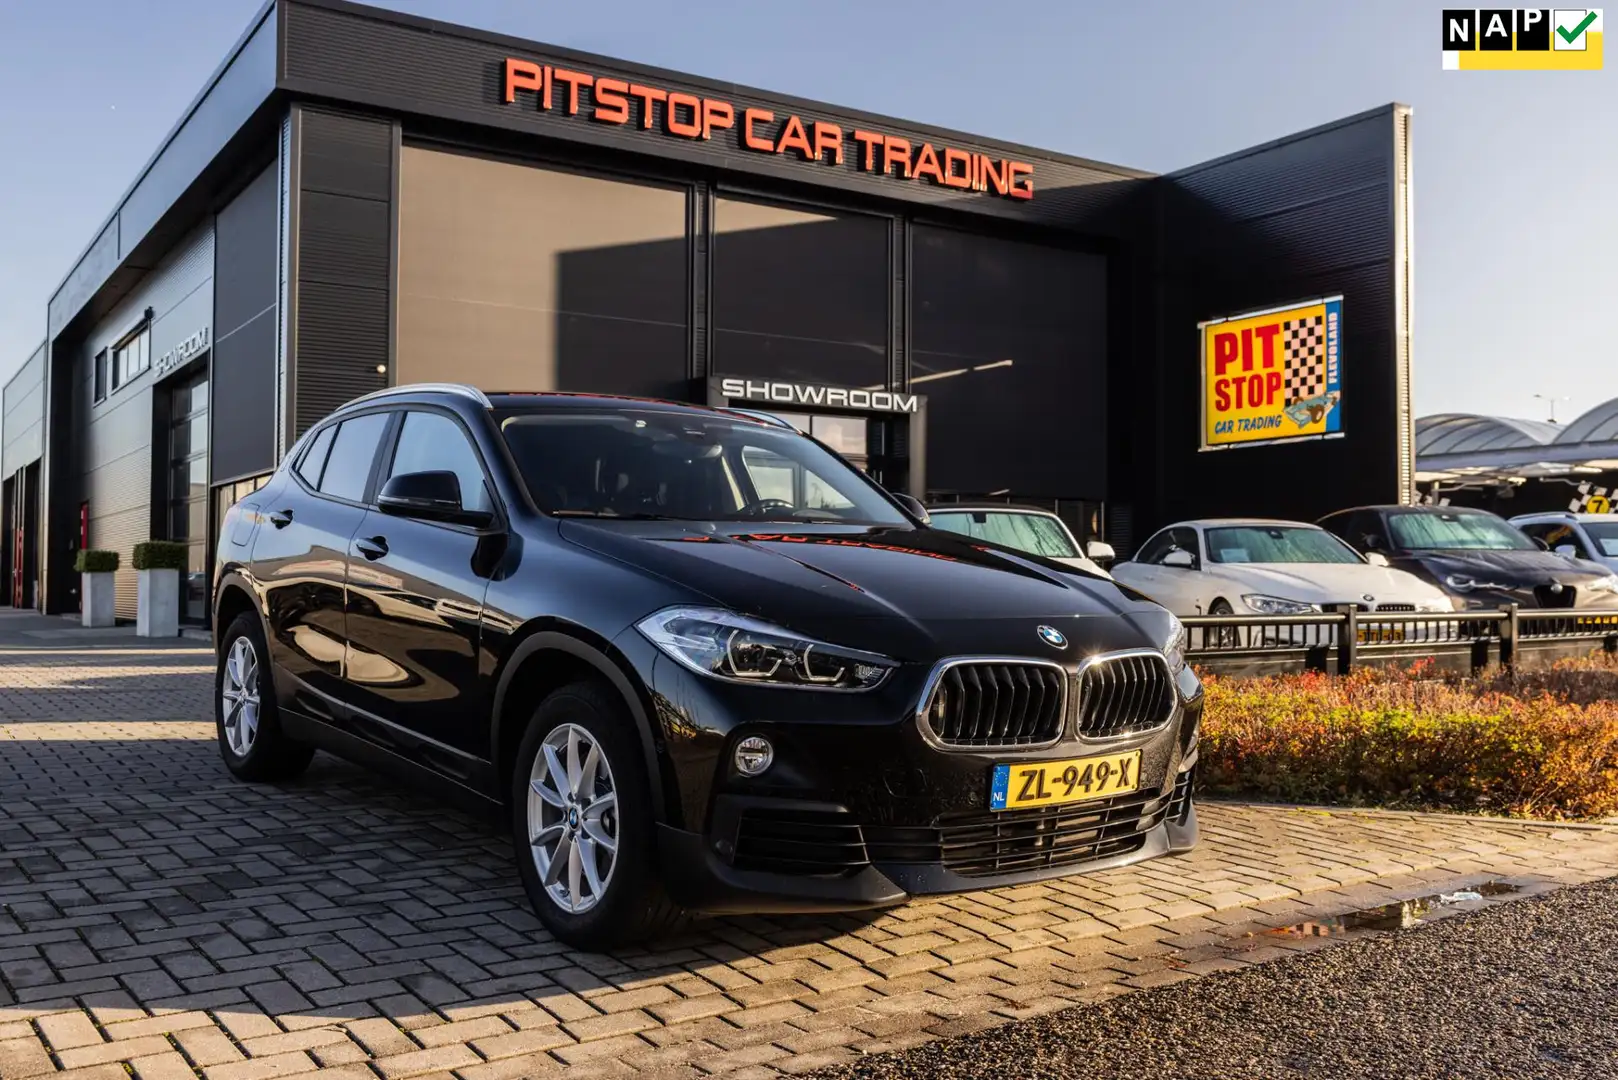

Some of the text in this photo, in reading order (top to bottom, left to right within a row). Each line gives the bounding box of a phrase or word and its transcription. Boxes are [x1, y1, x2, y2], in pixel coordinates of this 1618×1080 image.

[505, 57, 1034, 200] PITSTOP CAR TRADING
[1214, 324, 1280, 376] PIT
[1328, 312, 1338, 384] FLEVOLAND
[722, 378, 918, 412] SHOWROOM
[1215, 371, 1282, 412] STOP
[1215, 414, 1282, 434] CAR TRADING
[1592, 500, 1603, 513] 7
[993, 792, 1005, 801] NL
[1016, 758, 1133, 801] ZL-949-X
